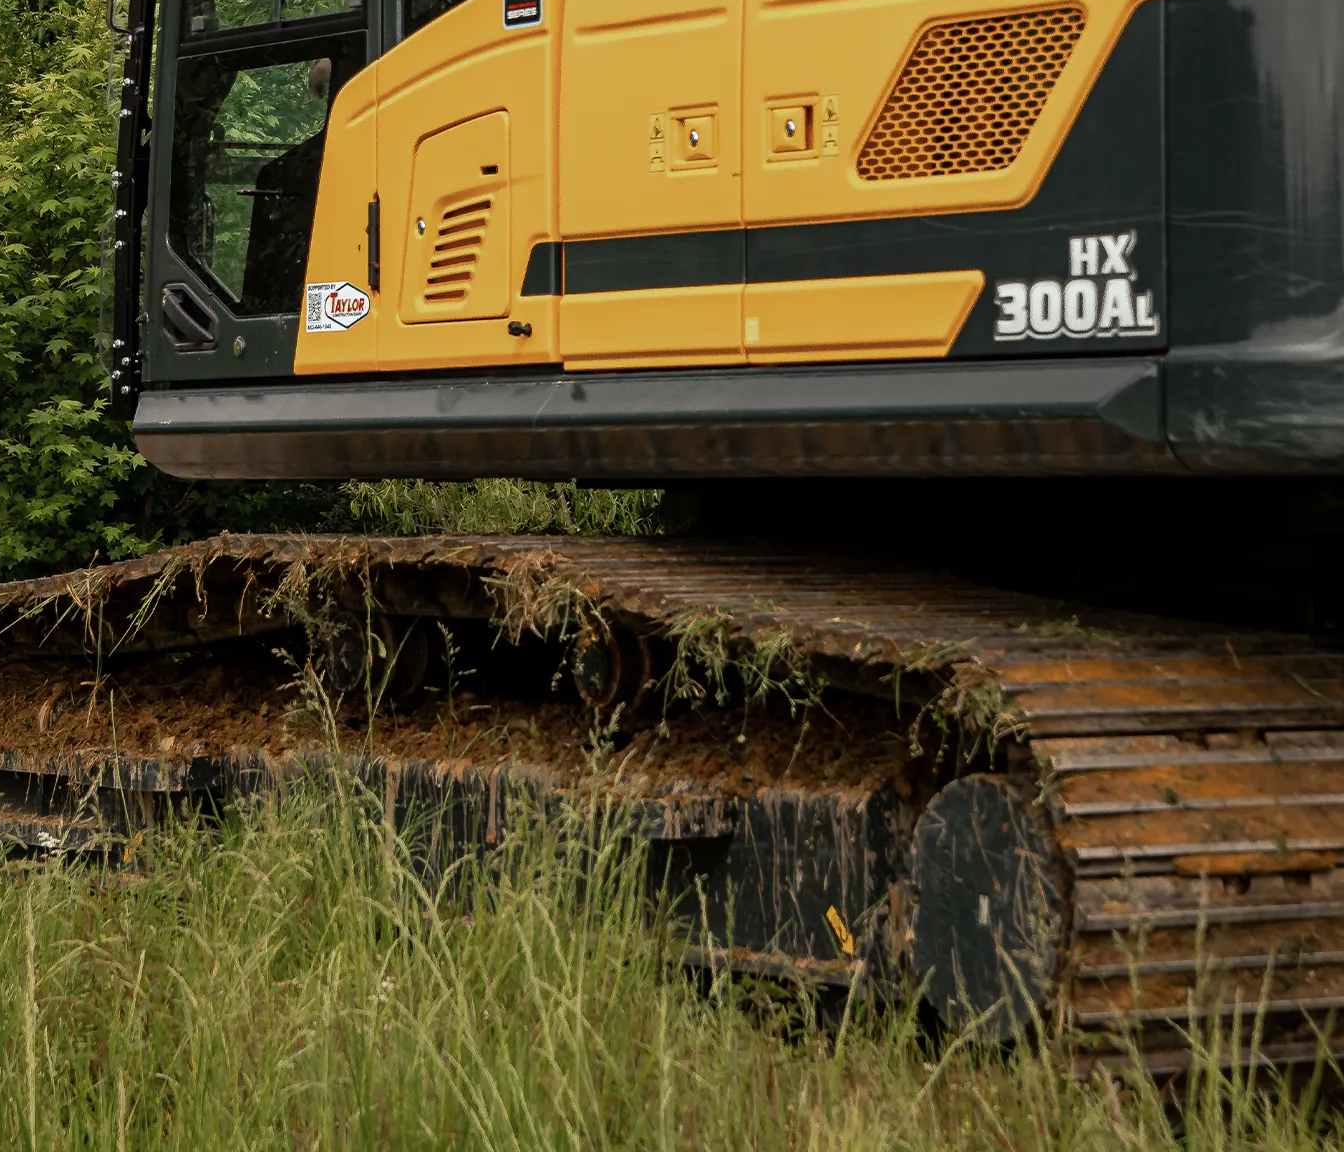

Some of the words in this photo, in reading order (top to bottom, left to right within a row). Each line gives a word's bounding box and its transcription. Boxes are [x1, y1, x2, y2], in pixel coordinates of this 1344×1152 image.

[507, 6, 537, 19] SERIES
[1069, 233, 1131, 276] HX
[330, 292, 365, 313] TAYLOR
